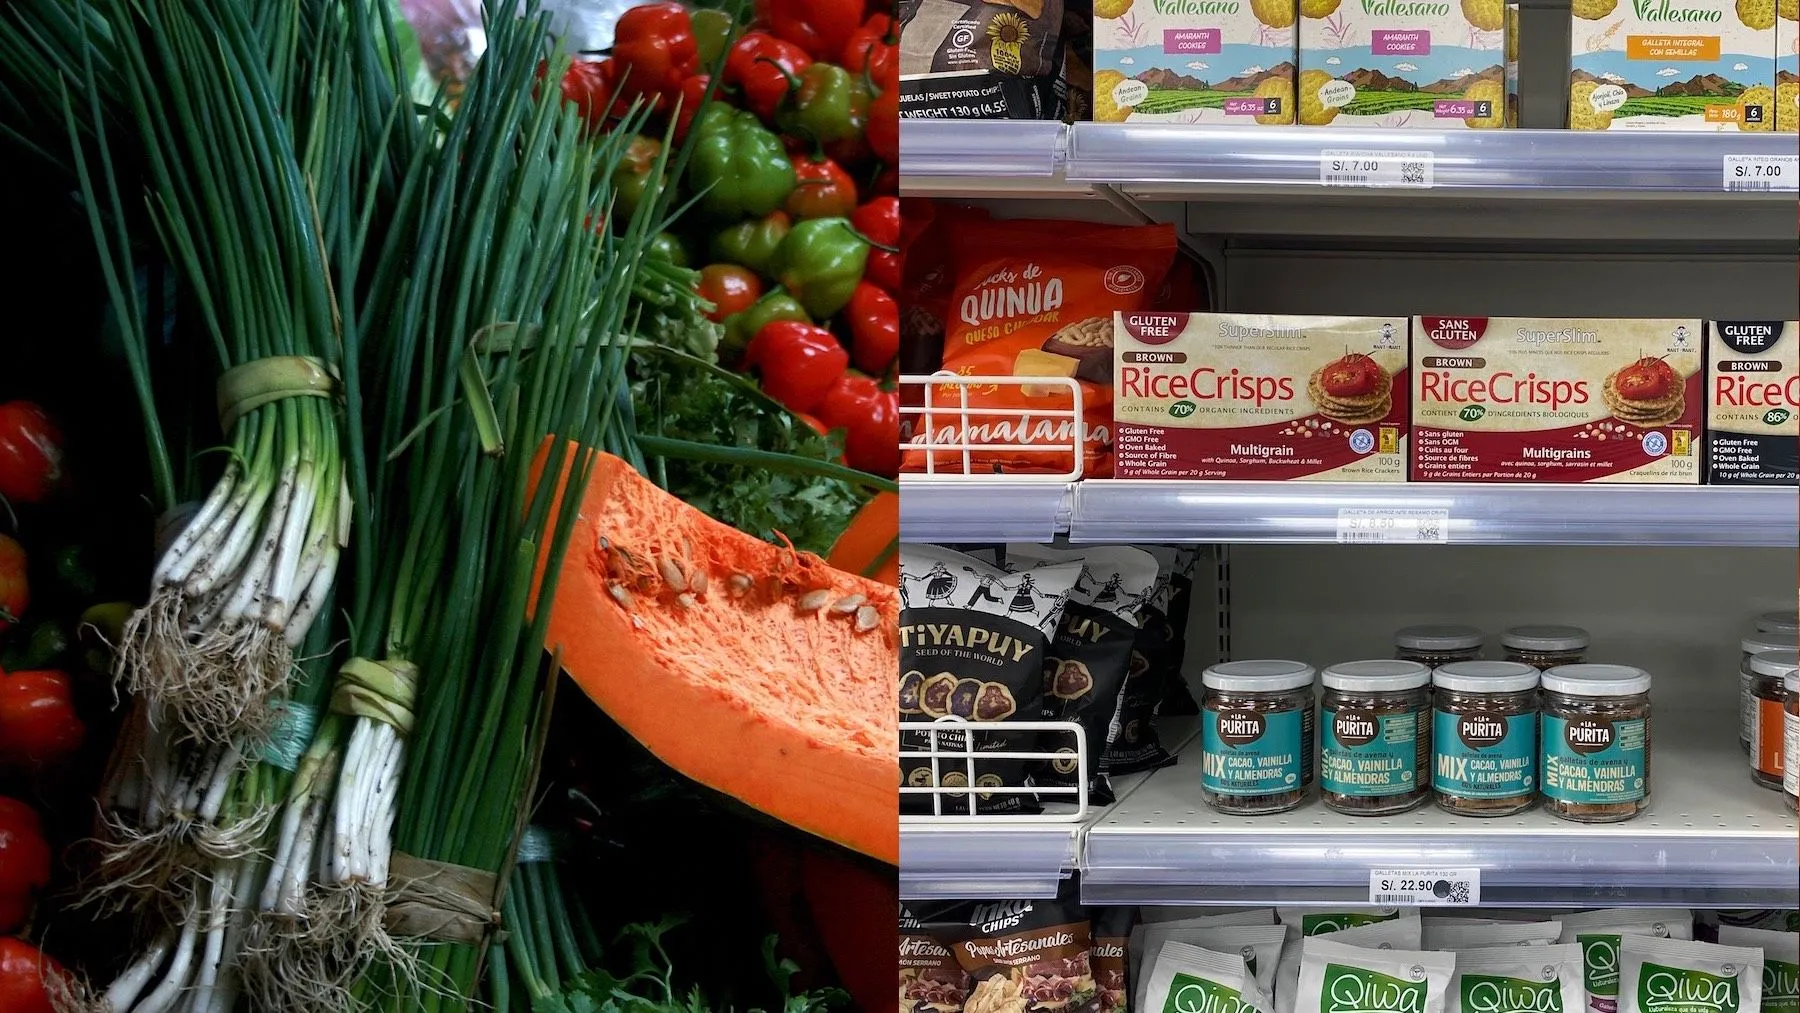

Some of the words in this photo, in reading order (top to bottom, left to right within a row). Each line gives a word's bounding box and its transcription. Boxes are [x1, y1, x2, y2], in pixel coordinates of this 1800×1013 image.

[1632, 0, 1722, 23] Vallesano
[957, 34, 970, 43] GF
[1174, 32, 1210, 40] AMARANTH
[1382, 33, 1419, 41] AMARANTH
[1177, 41, 1206, 49] COOKIES
[1386, 43, 1416, 51] COOKIES
[1641, 39, 1671, 47] GALLETA
[1673, 39, 1704, 47] INTEGRAL
[1650, 48, 1664, 56] CON
[1665, 48, 1697, 56] SEMILLAS
[929, 91, 951, 100] SWEET
[952, 89, 979, 99] POTATO
[1118, 84, 1142, 95] Andean
[1324, 86, 1349, 96] Andean
[1269, 99, 1277, 109] 6
[1326, 93, 1349, 104] Grains
[950, 106, 971, 117] 130
[972, 107, 980, 117] g
[1479, 102, 1487, 111] 6
[1751, 108, 1758, 117] 6
[1332, 160, 1348, 171] S/.
[1352, 160, 1378, 171] 7.00
[1735, 166, 1751, 177] S/.
[1755, 165, 1781, 176] 7.00
[1023, 263, 1042, 280] de
[961, 278, 1063, 326] QUINUA
[1129, 316, 1177, 326] GLUTEN
[1439, 319, 1469, 330] SANS
[965, 325, 1000, 345] QUESO
[1140, 326, 1169, 337] FREE
[1431, 329, 1477, 340] GLUTEN
[1725, 325, 1771, 336] GLUTEN
[1736, 335, 1765, 346] FREE
[1135, 353, 1173, 362] BROWN
[1435, 358, 1473, 367] BROWN
[1731, 362, 1768, 371] BROWN
[1121, 367, 1294, 408] RiceCrisps
[1421, 371, 1589, 411] RiceCrisps
[1121, 405, 1165, 414] CONTAINS
[1173, 404, 1194, 415] 70%
[1240, 407, 1294, 415] INGREDIENTS
[1463, 408, 1484, 418] 70%
[1716, 413, 1759, 421] CONTAINS
[1767, 411, 1787, 422] 86%
[1230, 444, 1294, 458] Multigrain
[1523, 447, 1591, 460] Multigrains
[1378, 457, 1393, 466] 100
[1394, 459, 1400, 468] g
[1671, 460, 1686, 468] 100
[1686, 462, 1692, 470] g
[1369, 519, 1394, 529] 8.50
[916, 648, 939, 656] SEED
[954, 650, 972, 659] THE
[973, 652, 1004, 667] WORLD
[1220, 719, 1260, 735] PURITA
[1336, 720, 1374, 736] PURITA
[1463, 722, 1502, 737] PURITA
[1584, 720, 1592, 728] LA
[1569, 727, 1610, 743] PURITA
[1203, 751, 1226, 779] MIX
[1228, 757, 1255, 769] CACAO,
[1256, 754, 1292, 766] VAINILLA
[1329, 757, 1355, 772] CACAO,
[1358, 758, 1402, 772] VAINILLA
[1437, 753, 1468, 781] MIX
[1470, 759, 1498, 772] CACAO,
[1499, 756, 1530, 769] VAINILLA
[1228, 769, 1233, 779] Y
[1234, 768, 1283, 780] ALMENDRAS
[1470, 773, 1475, 782] Y
[1476, 770, 1522, 783] ALMENDRAS
[1546, 754, 1559, 788] MIX
[1559, 764, 1591, 780] CACAO,
[1593, 765, 1636, 779] VAINILLA
[1333, 771, 1390, 784] ALMENDRAS
[1558, 779, 1564, 789] Y
[1566, 779, 1625, 793] ALMENDRAS
[1381, 879, 1396, 891] S/.
[1400, 880, 1432, 891] 22.90
[982, 915, 1021, 933] CHIPS
[996, 932, 1073, 958] Artesanales
[1012, 954, 1041, 966] SERRANO
[1331, 974, 1421, 1013] Qiwa
[1646, 972, 1735, 1007] Qiwa
[1469, 980, 1560, 1013] Qiwa
